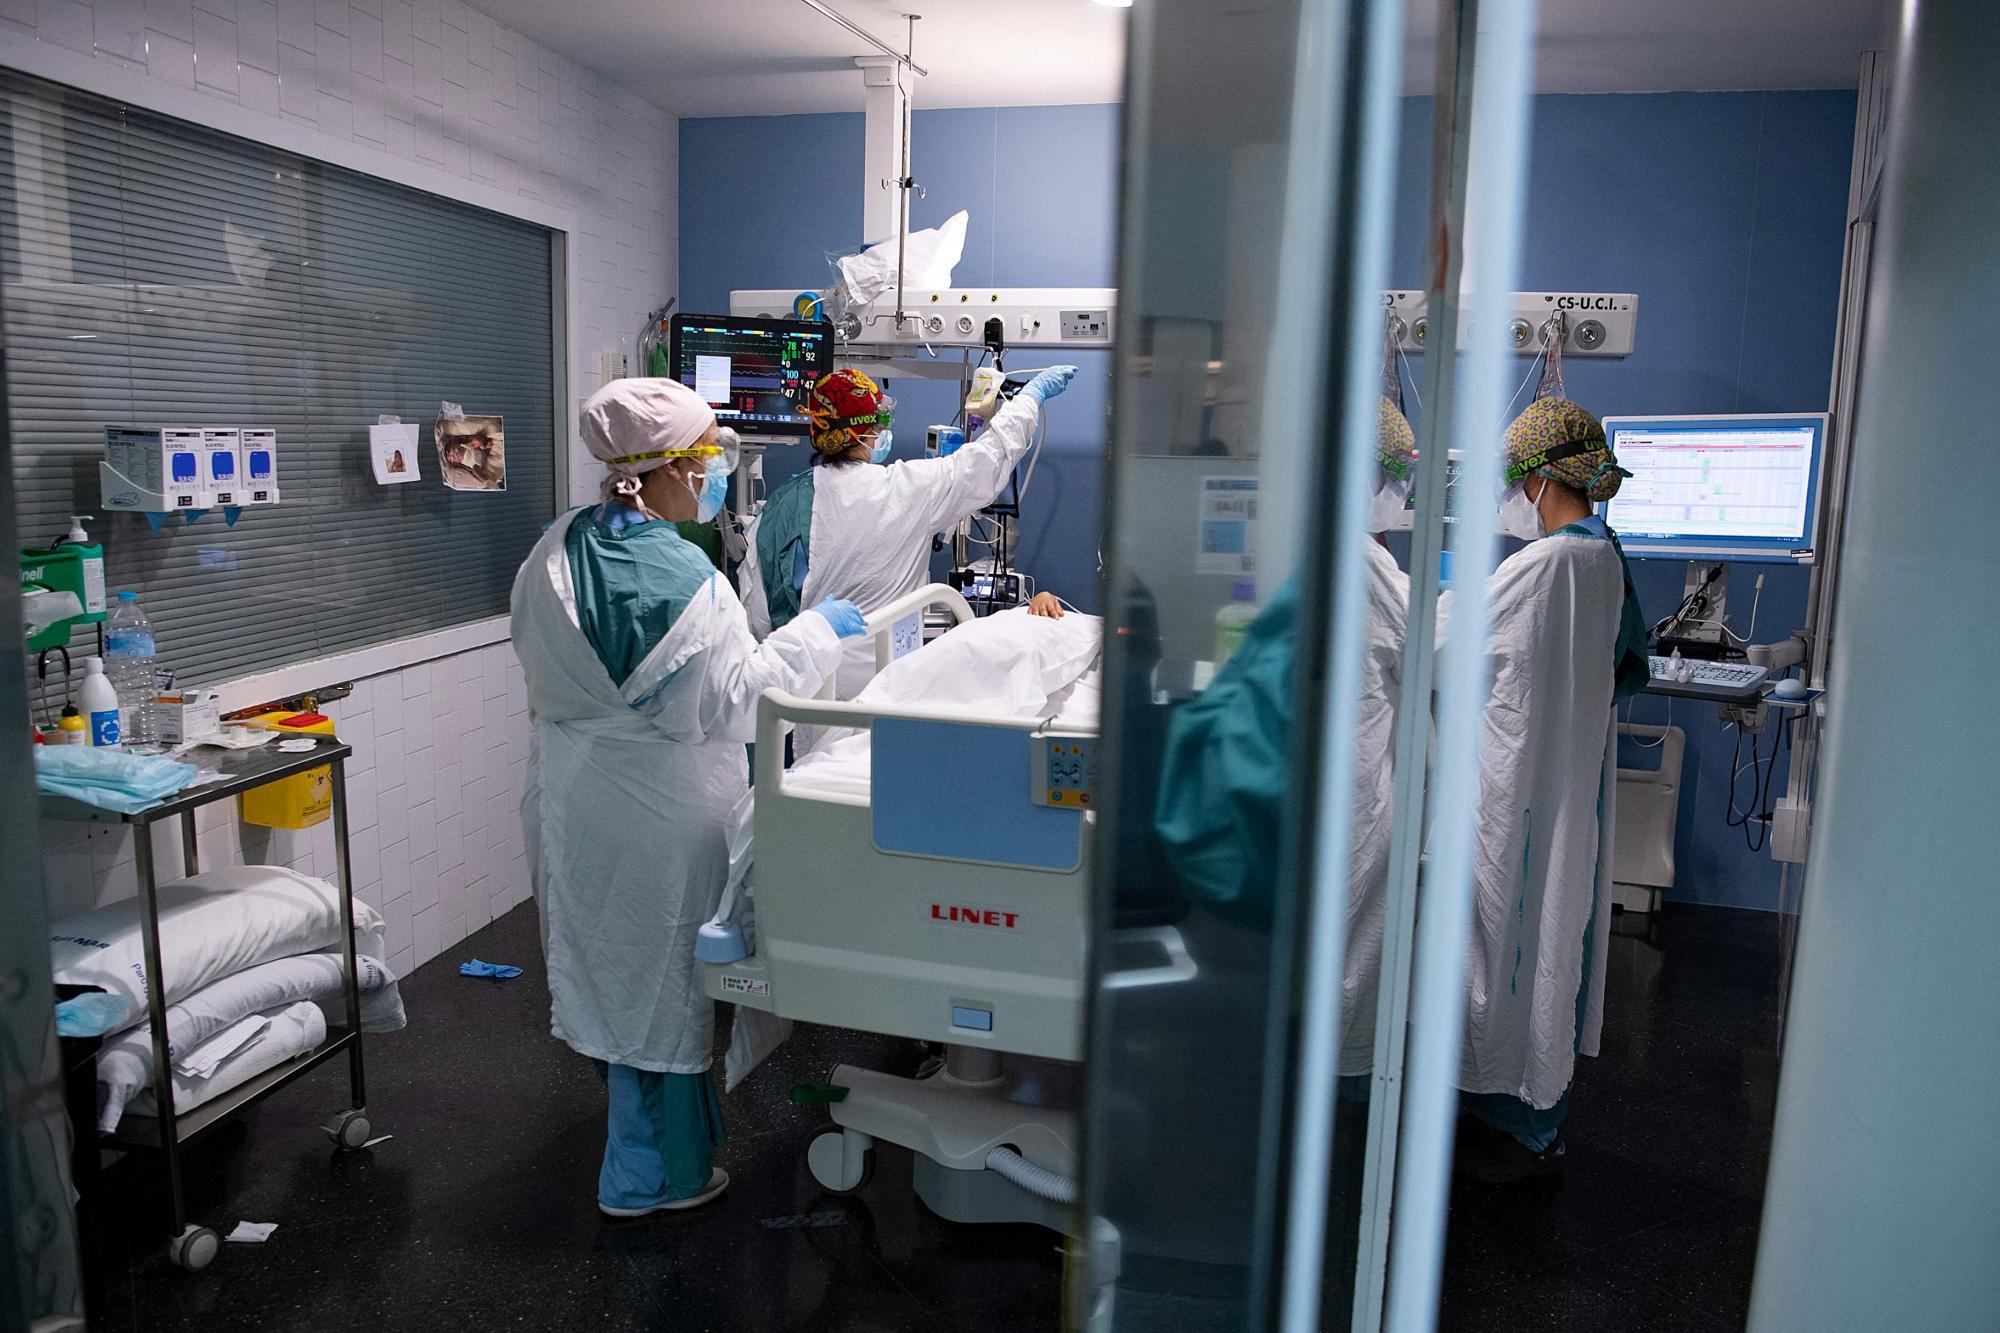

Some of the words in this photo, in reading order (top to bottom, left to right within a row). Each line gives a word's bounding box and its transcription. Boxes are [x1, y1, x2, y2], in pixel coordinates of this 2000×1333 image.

[1557, 297, 1618, 310] CS-U.C.I.
[787, 342, 797, 351] 78
[805, 352, 815, 361] 92
[786, 370, 798, 379] 100
[804, 380, 814, 389] 47
[784, 389, 795, 398] 47
[850, 415, 877, 426] uvex
[1517, 452, 1549, 474] vex
[20, 565, 45, 582] nell
[931, 904, 1019, 929] LINET
